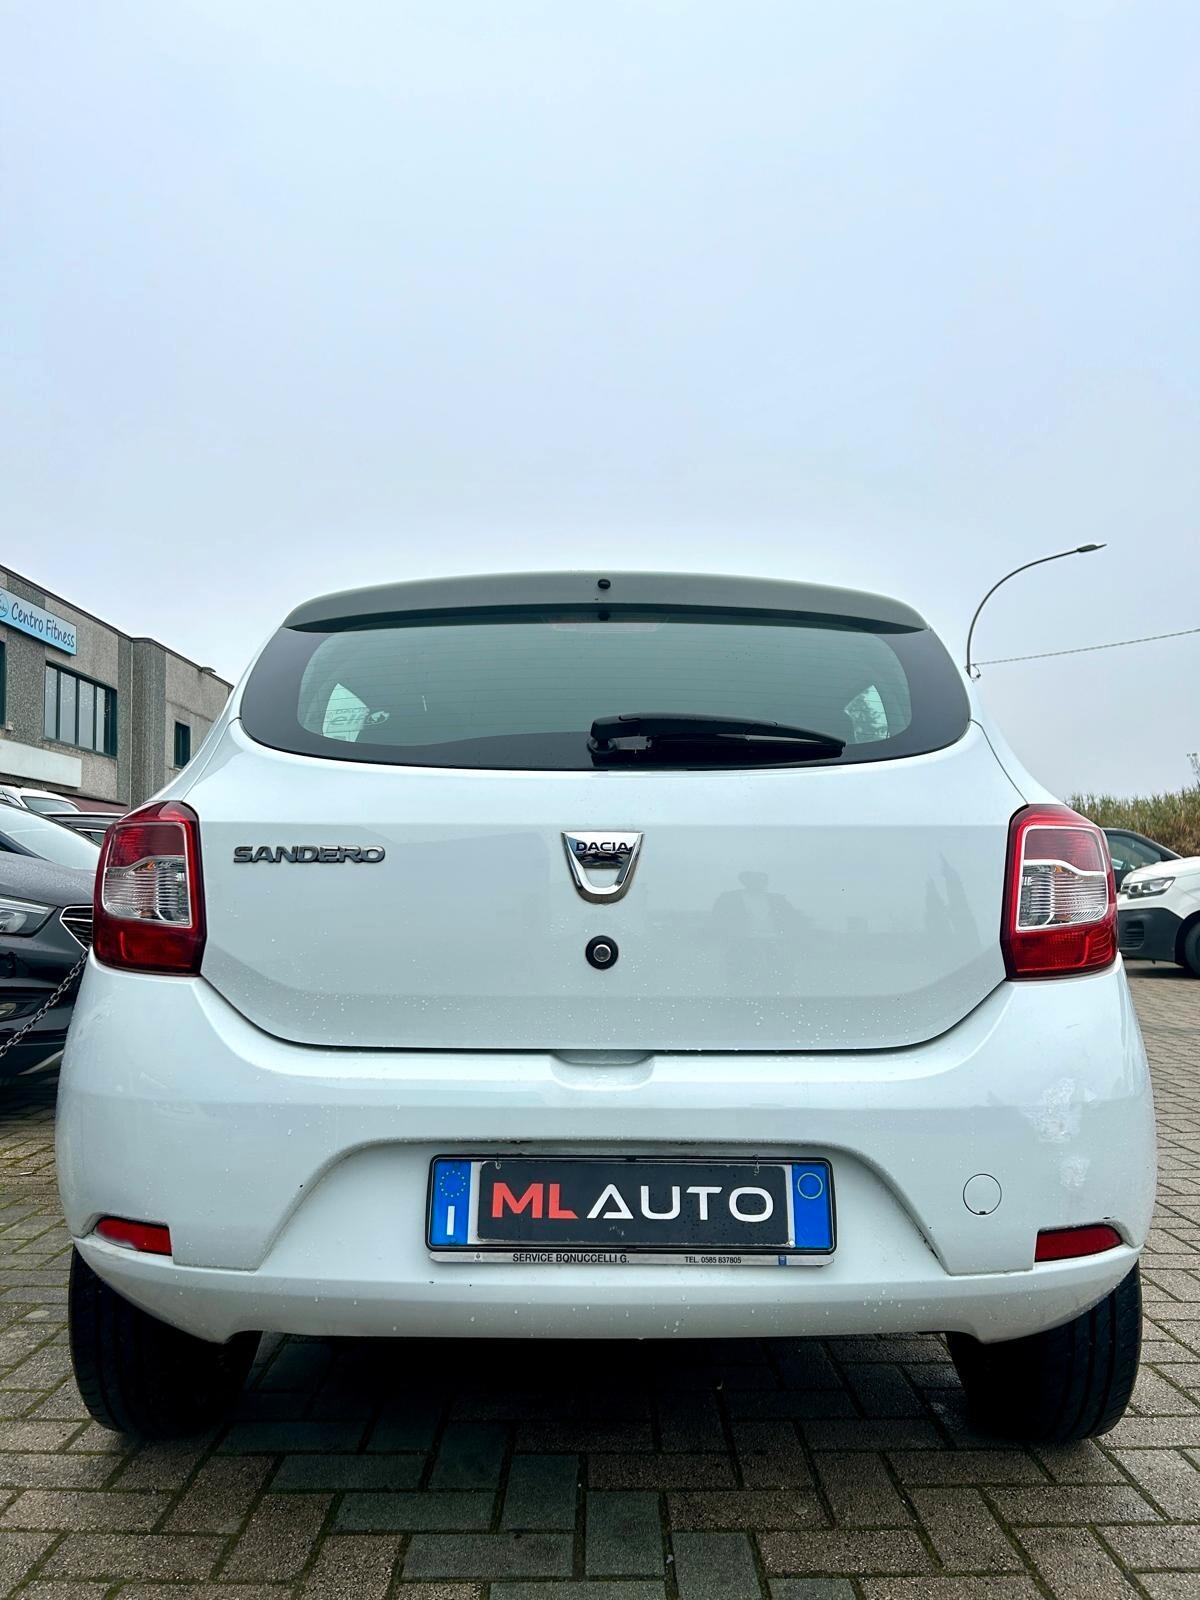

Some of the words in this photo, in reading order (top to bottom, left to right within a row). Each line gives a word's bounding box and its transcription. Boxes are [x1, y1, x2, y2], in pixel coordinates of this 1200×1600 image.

[11, 602, 44, 633] Centro
[46, 619, 75, 648] Fitness
[233, 845, 386, 864] SANDERO
[576, 842, 629, 852] DACIA
[491, 1182, 579, 1220] ML
[586, 1183, 774, 1223] AUTO
[512, 1253, 554, 1263] SERVICE
[555, 1253, 617, 1264] BONUCCELLI
[619, 1254, 631, 1264] G.
[684, 1256, 700, 1264] TEL.
[701, 1256, 717, 1265] 0585
[718, 1256, 742, 1265] 837805
